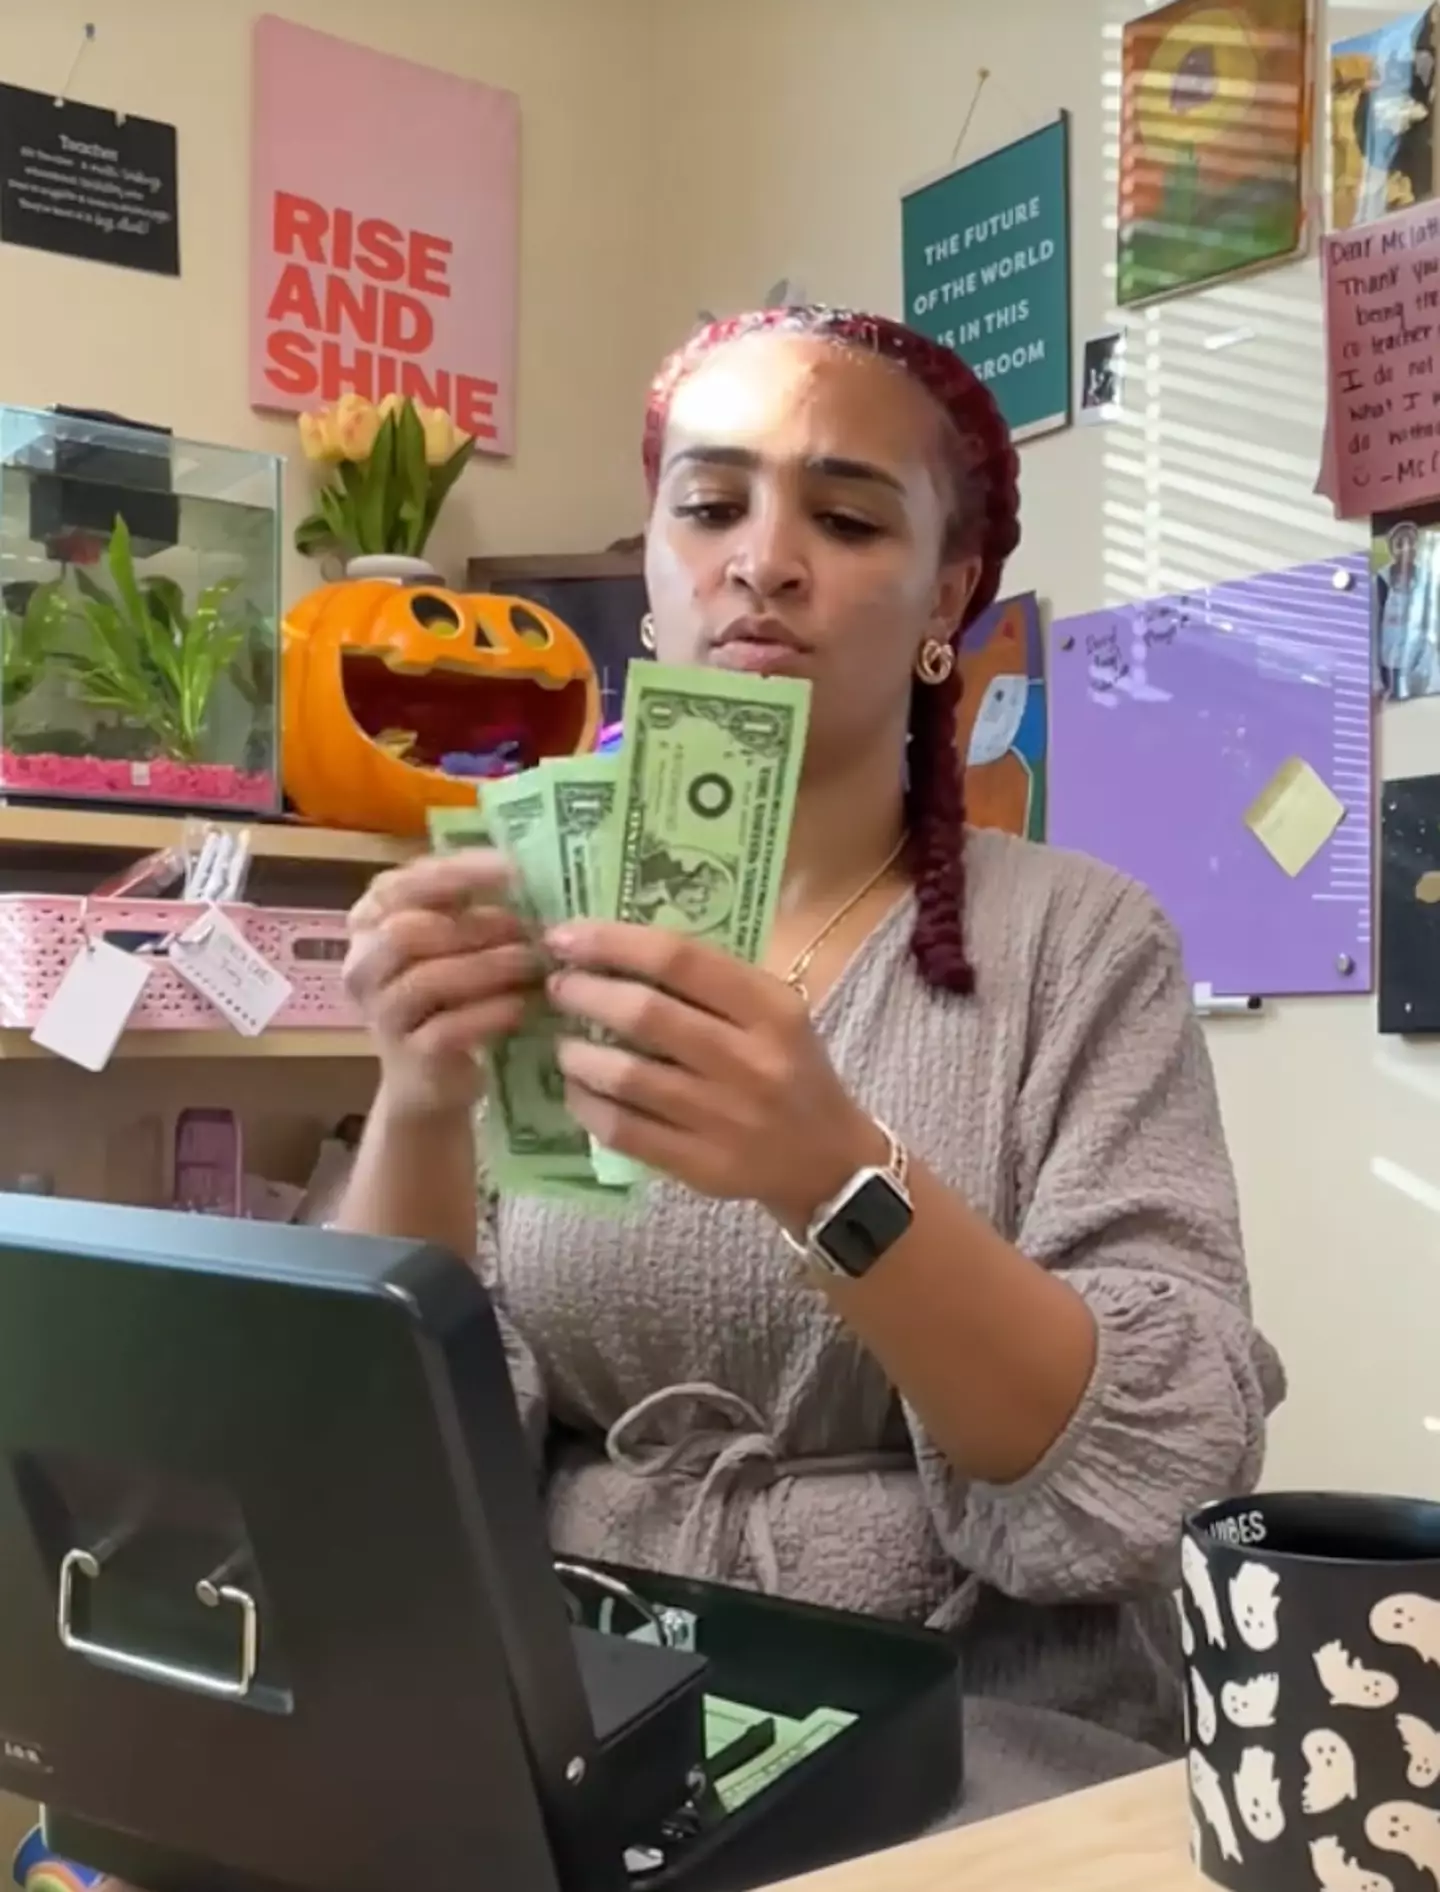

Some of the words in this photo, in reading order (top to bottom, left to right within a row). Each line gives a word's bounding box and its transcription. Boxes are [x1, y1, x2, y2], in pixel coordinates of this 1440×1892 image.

[273, 190, 453, 298] RISE
[924, 233, 960, 265] THE
[964, 196, 1041, 249] FUTURE
[266, 262, 434, 355] AND
[913, 288, 939, 315] OF
[940, 272, 977, 304] THE
[980, 239, 1055, 287] WORLD
[959, 319, 980, 344] IN
[983, 298, 1029, 334] THIS
[263, 329, 498, 439] SHINE
[972, 338, 1045, 381] SROOM
